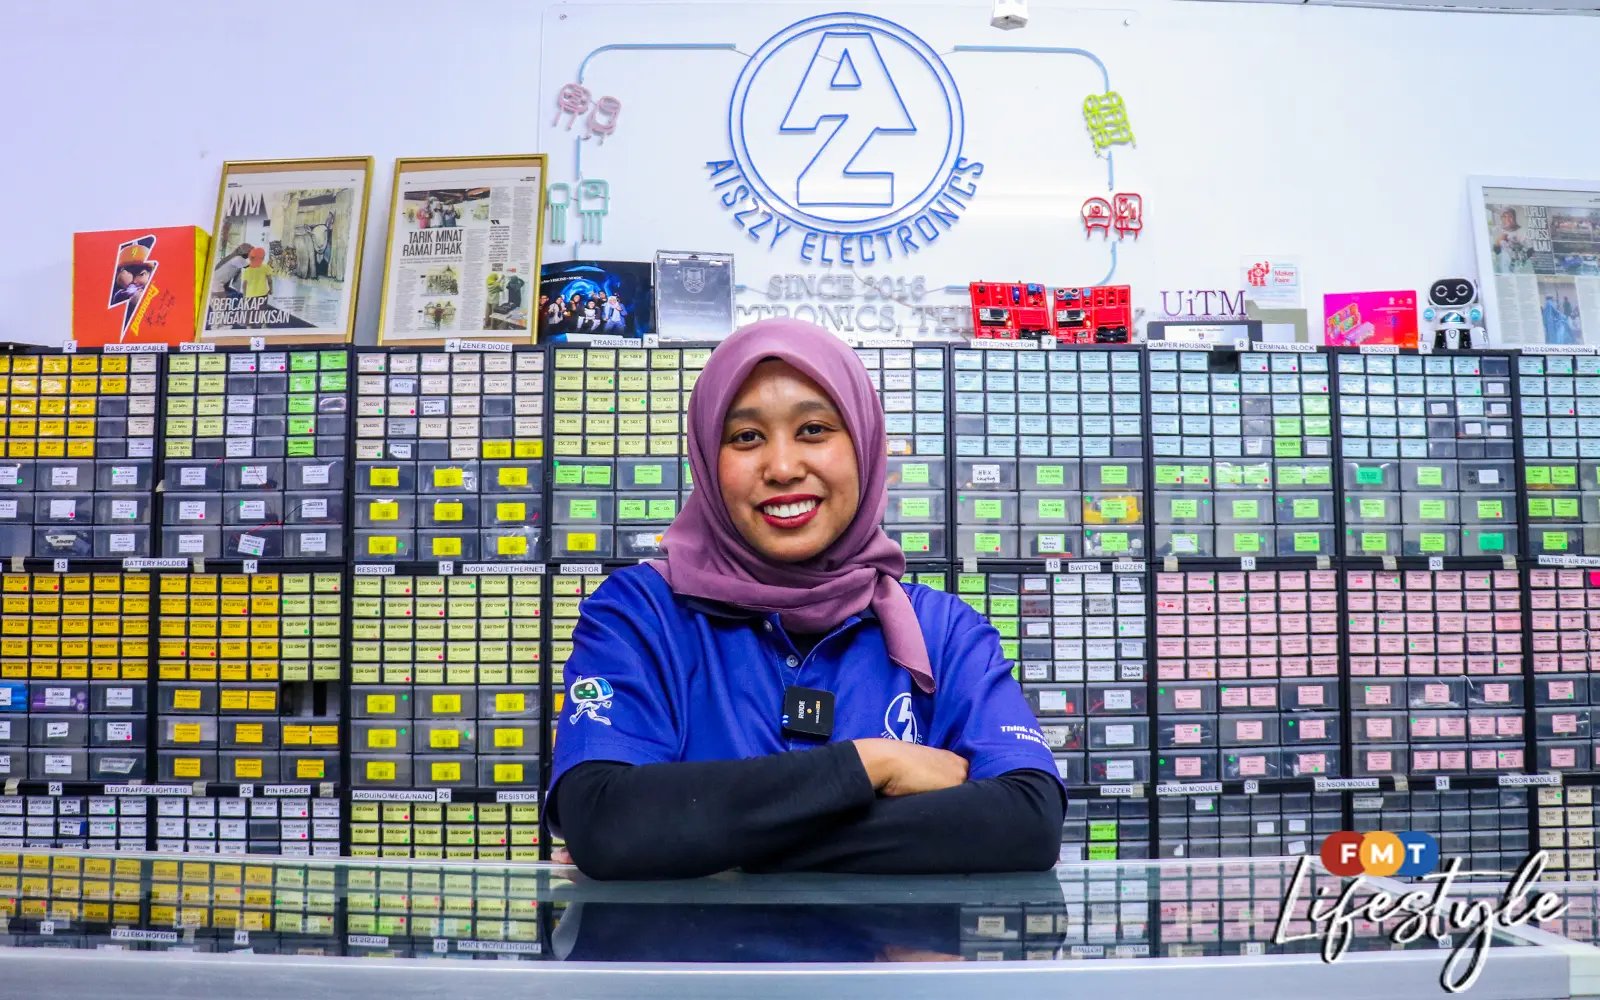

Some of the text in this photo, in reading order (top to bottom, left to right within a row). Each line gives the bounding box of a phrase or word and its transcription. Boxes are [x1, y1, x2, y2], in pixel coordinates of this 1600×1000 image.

[706, 157, 984, 264] AISZZY ELECTRONICS
[409, 229, 463, 244] TARIK MINAT
[402, 243, 462, 257] RAMAI PIHAK
[767, 274, 927, 300] SINCE 2016
[1160, 290, 1247, 317] UiTM
[208, 310, 290, 325] DENGAN LUKISAN
[67, 342, 72, 350] 2
[449, 341, 455, 349] 4
[1047, 338, 1052, 346] 7
[462, 342, 510, 351] ZENER DIODE
[56, 561, 66, 569] 13
[124, 559, 187, 567] BATTERY HOLDER
[245, 562, 256, 570] 14
[1048, 561, 1058, 569] 18
[1243, 559, 1253, 567] 19
[1431, 559, 1441, 567] 20
[464, 564, 485, 572] NODE
[1001, 725, 1028, 733] Think
[1015, 732, 1041, 744] Think
[1246, 782, 1257, 790] 30
[1347, 780, 1377, 788] MODULE
[1438, 779, 1447, 787] 31
[50, 784, 60, 792] 24
[106, 786, 150, 794] LED/TRAFFIC
[1102, 786, 1131, 794] BUZZER
